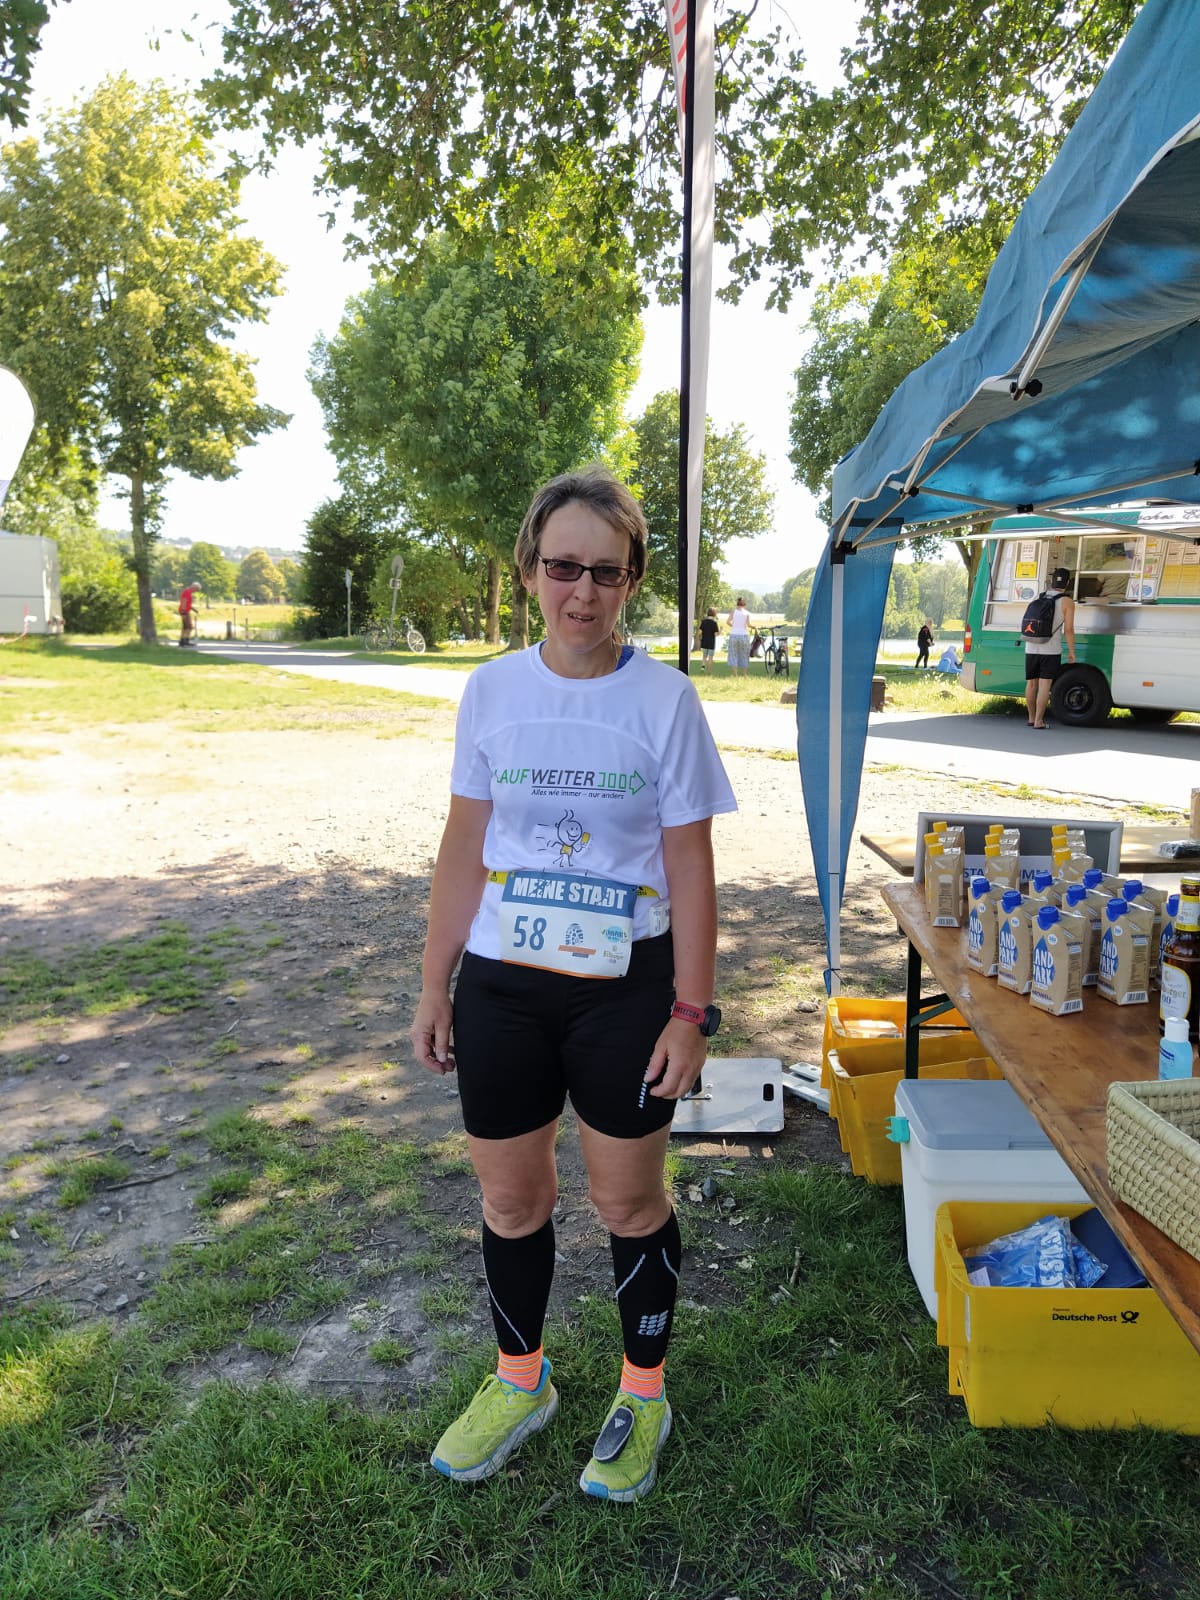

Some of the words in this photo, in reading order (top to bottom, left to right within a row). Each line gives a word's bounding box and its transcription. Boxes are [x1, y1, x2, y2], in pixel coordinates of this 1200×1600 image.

[561, 789, 582, 797] immer
[601, 791, 625, 800] anders
[512, 877, 565, 901] MEINE
[568, 882, 627, 909] STADT
[513, 915, 547, 951] 58
[1033, 948, 1054, 969] AND
[1052, 1313, 1095, 1321] Deutsche
[1097, 1313, 1117, 1322] Post
